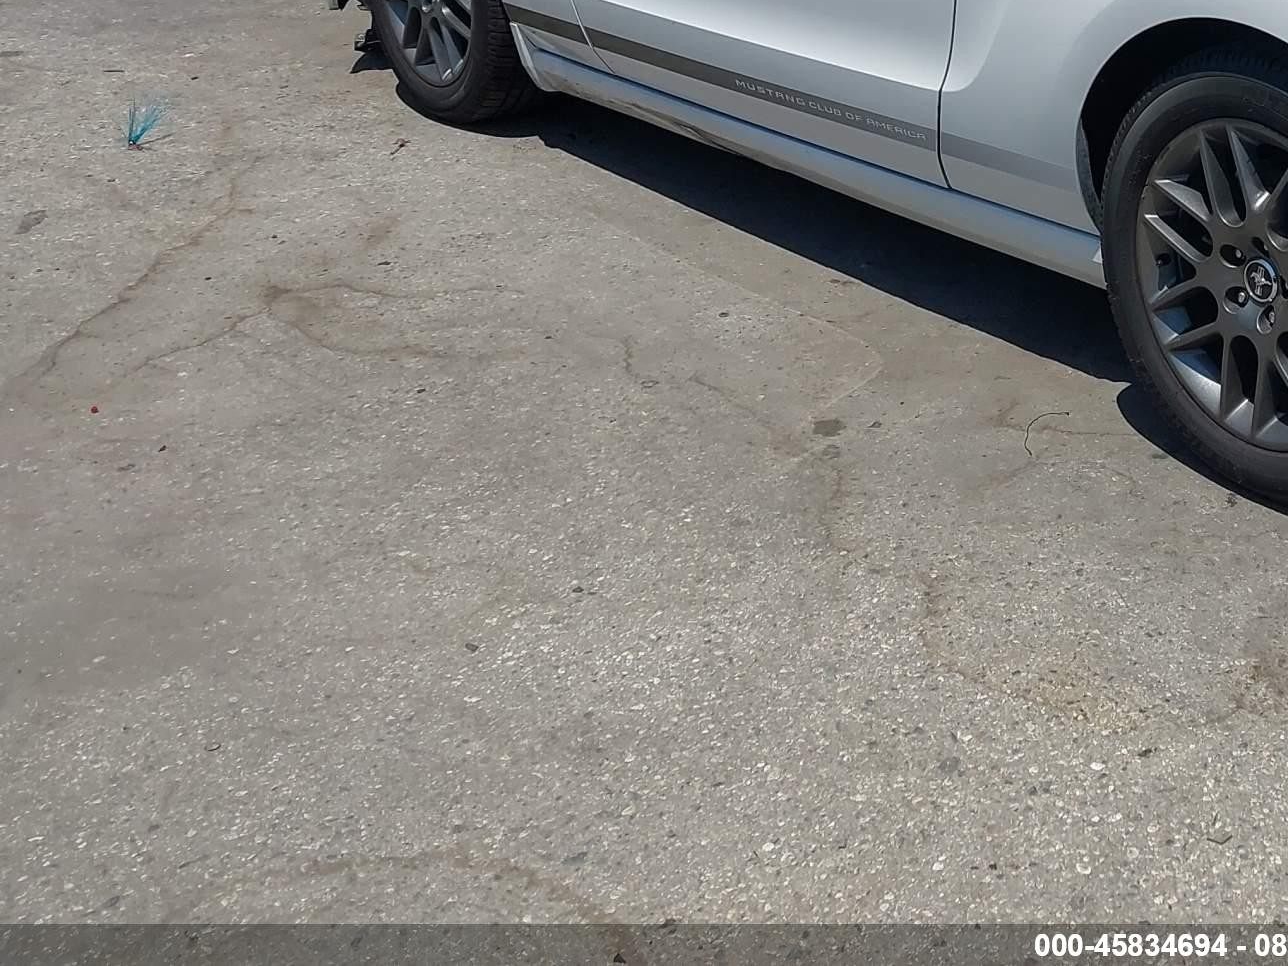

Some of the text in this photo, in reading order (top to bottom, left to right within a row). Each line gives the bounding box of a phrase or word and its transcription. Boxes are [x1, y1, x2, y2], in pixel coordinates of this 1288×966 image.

[735, 79, 927, 141] MUSTANG CLUB OF AMERICA
